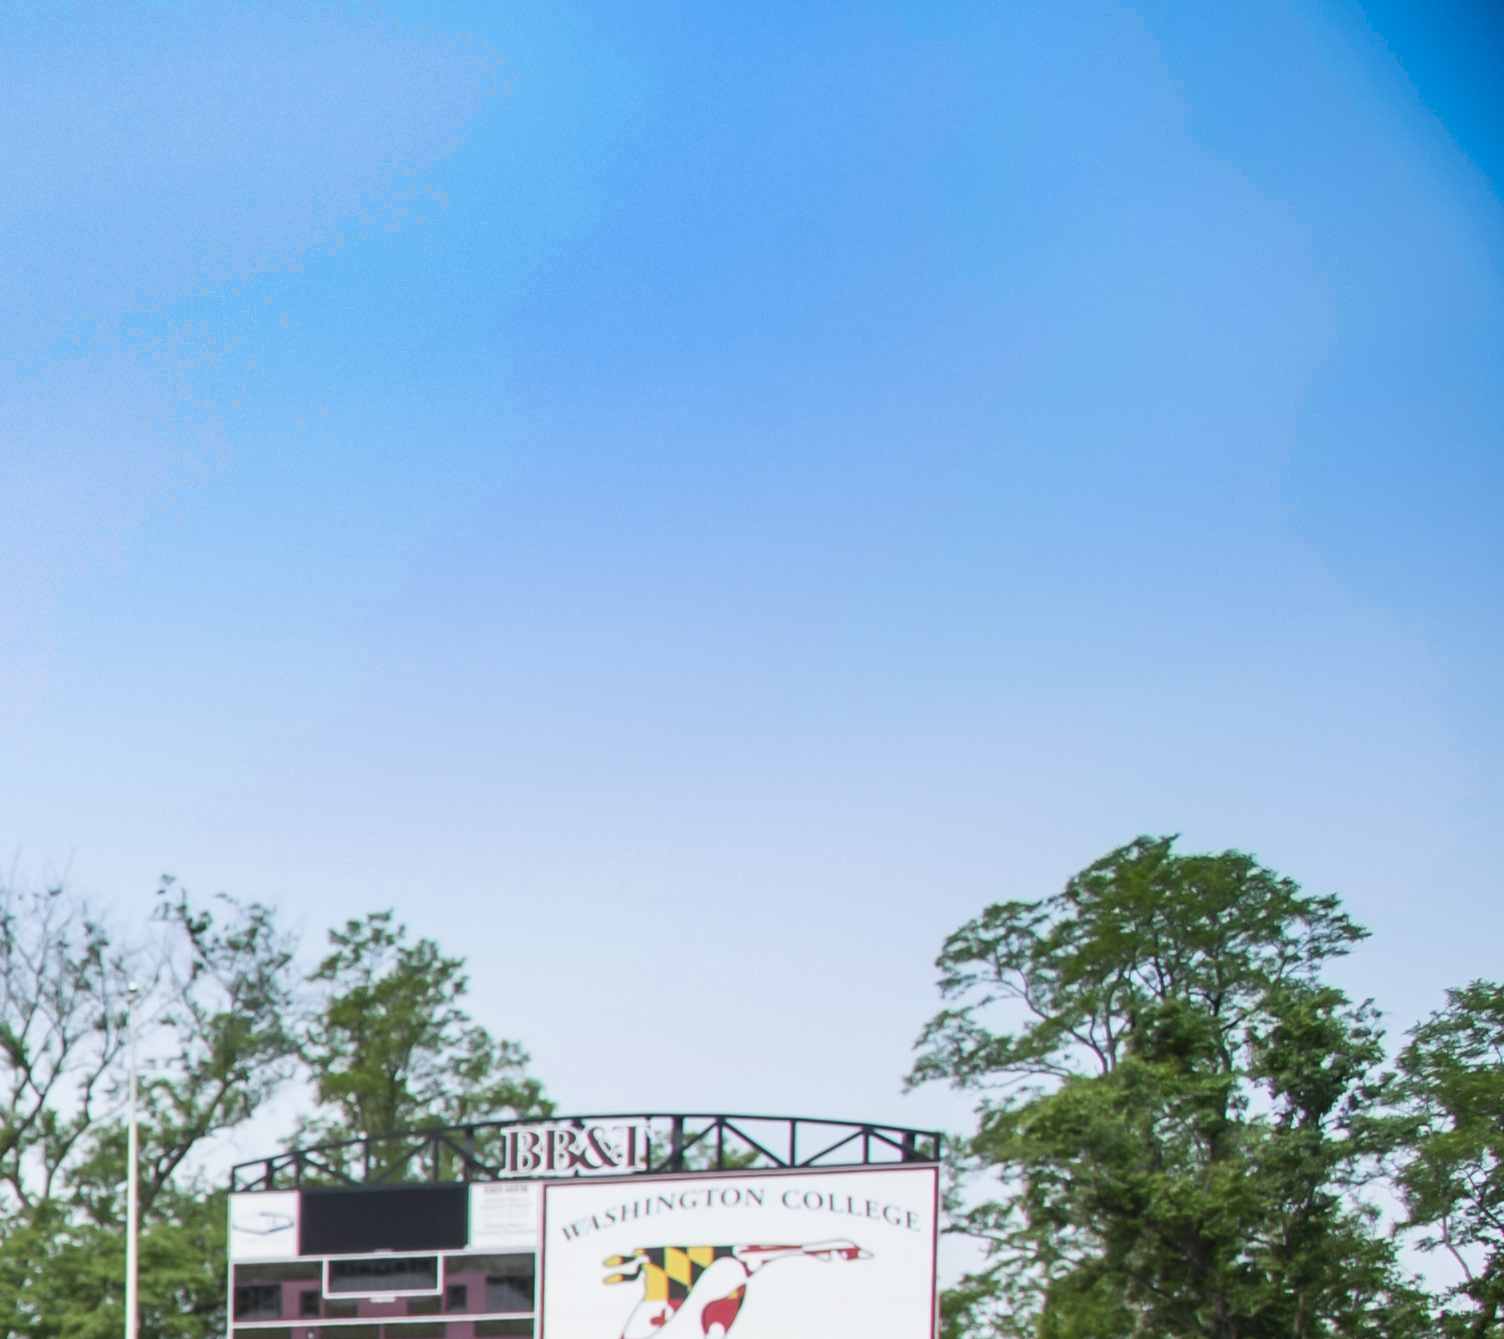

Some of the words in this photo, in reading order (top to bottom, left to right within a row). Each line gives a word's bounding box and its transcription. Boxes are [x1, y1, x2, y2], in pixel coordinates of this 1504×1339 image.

[499, 1122, 649, 1178] BB&T
[561, 1188, 766, 1242] WASHINGTON
[782, 1189, 921, 1232] COLLEGE
